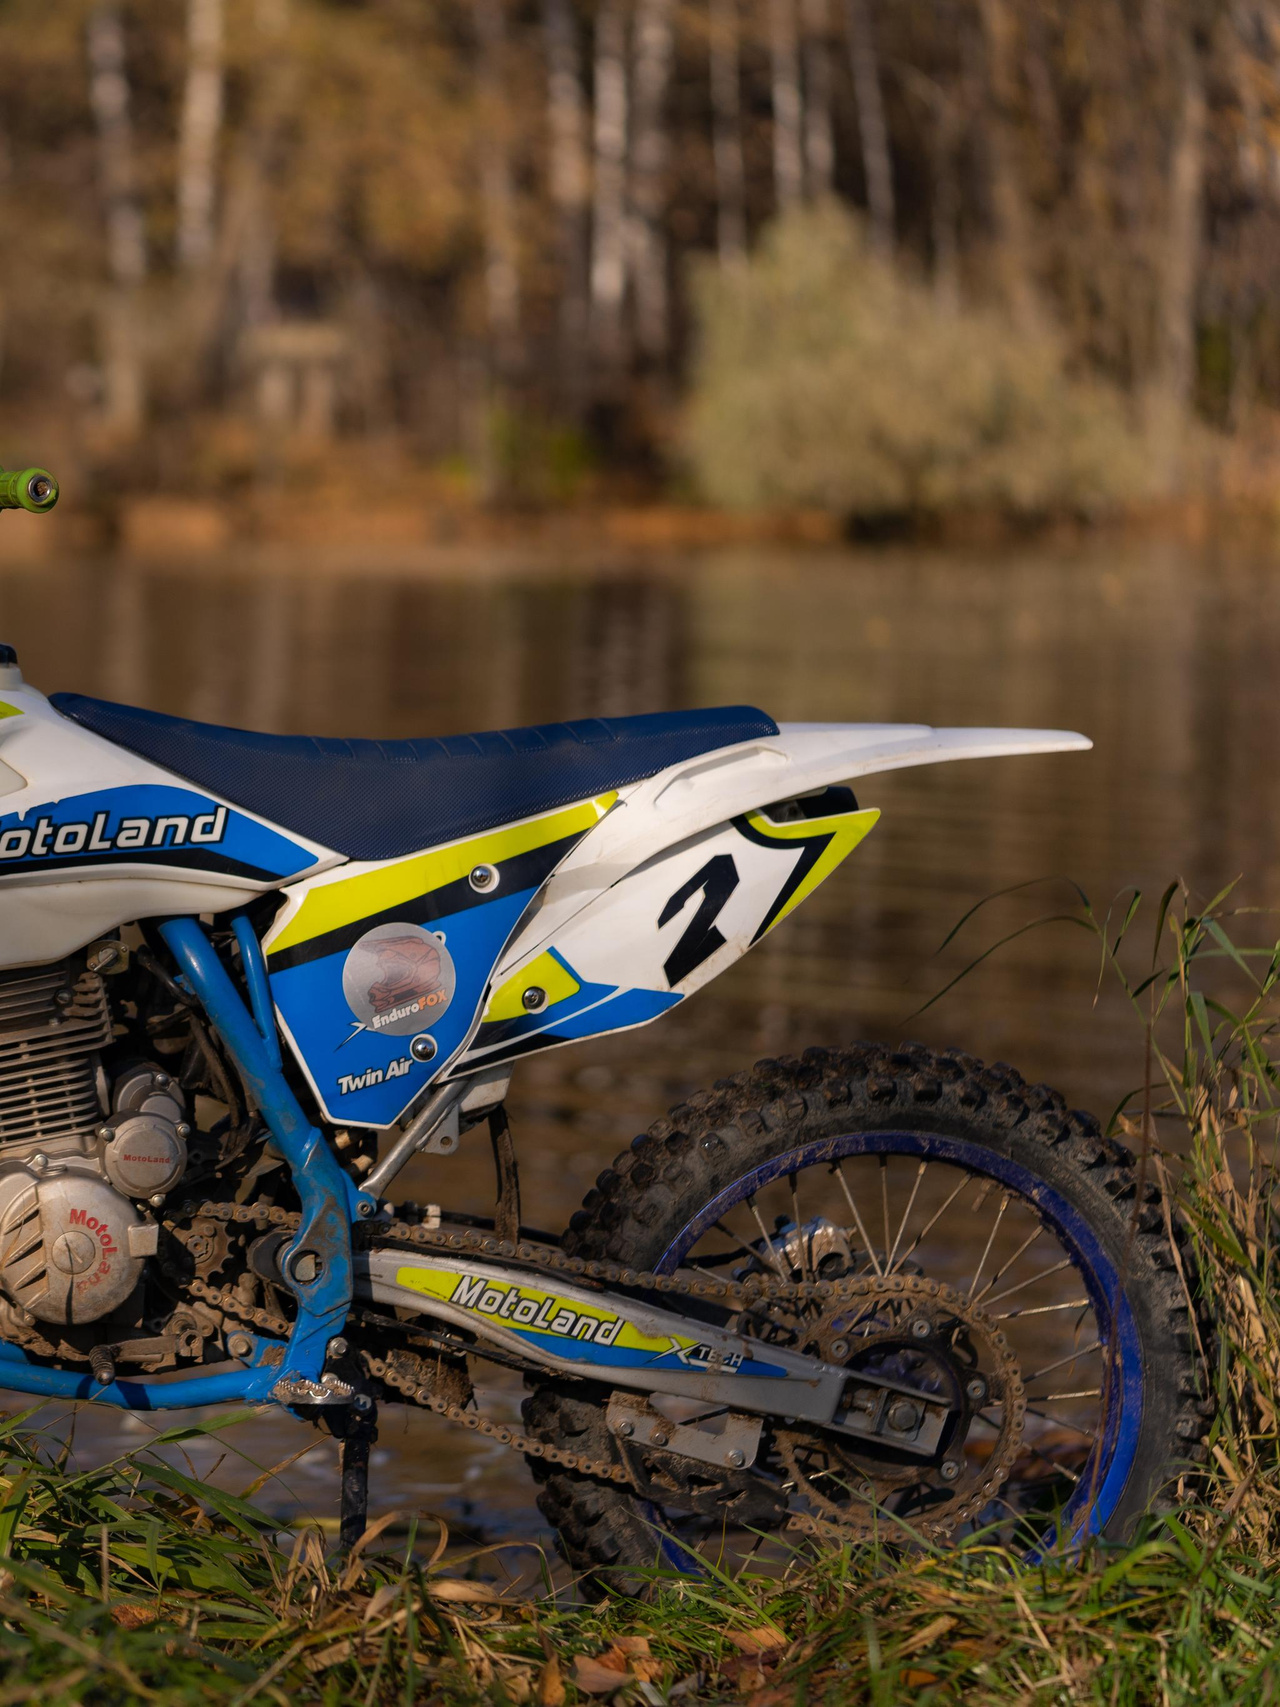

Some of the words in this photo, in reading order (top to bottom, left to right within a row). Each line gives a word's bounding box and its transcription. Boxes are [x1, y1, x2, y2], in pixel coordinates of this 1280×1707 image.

[656, 853, 740, 988] 2
[372, 988, 447, 1029] EnduroFOX
[337, 1067, 384, 1096] Twin
[385, 1056, 414, 1081] Air
[123, 1154, 170, 1164] MotoLand
[450, 1275, 626, 1346] MotoLand
